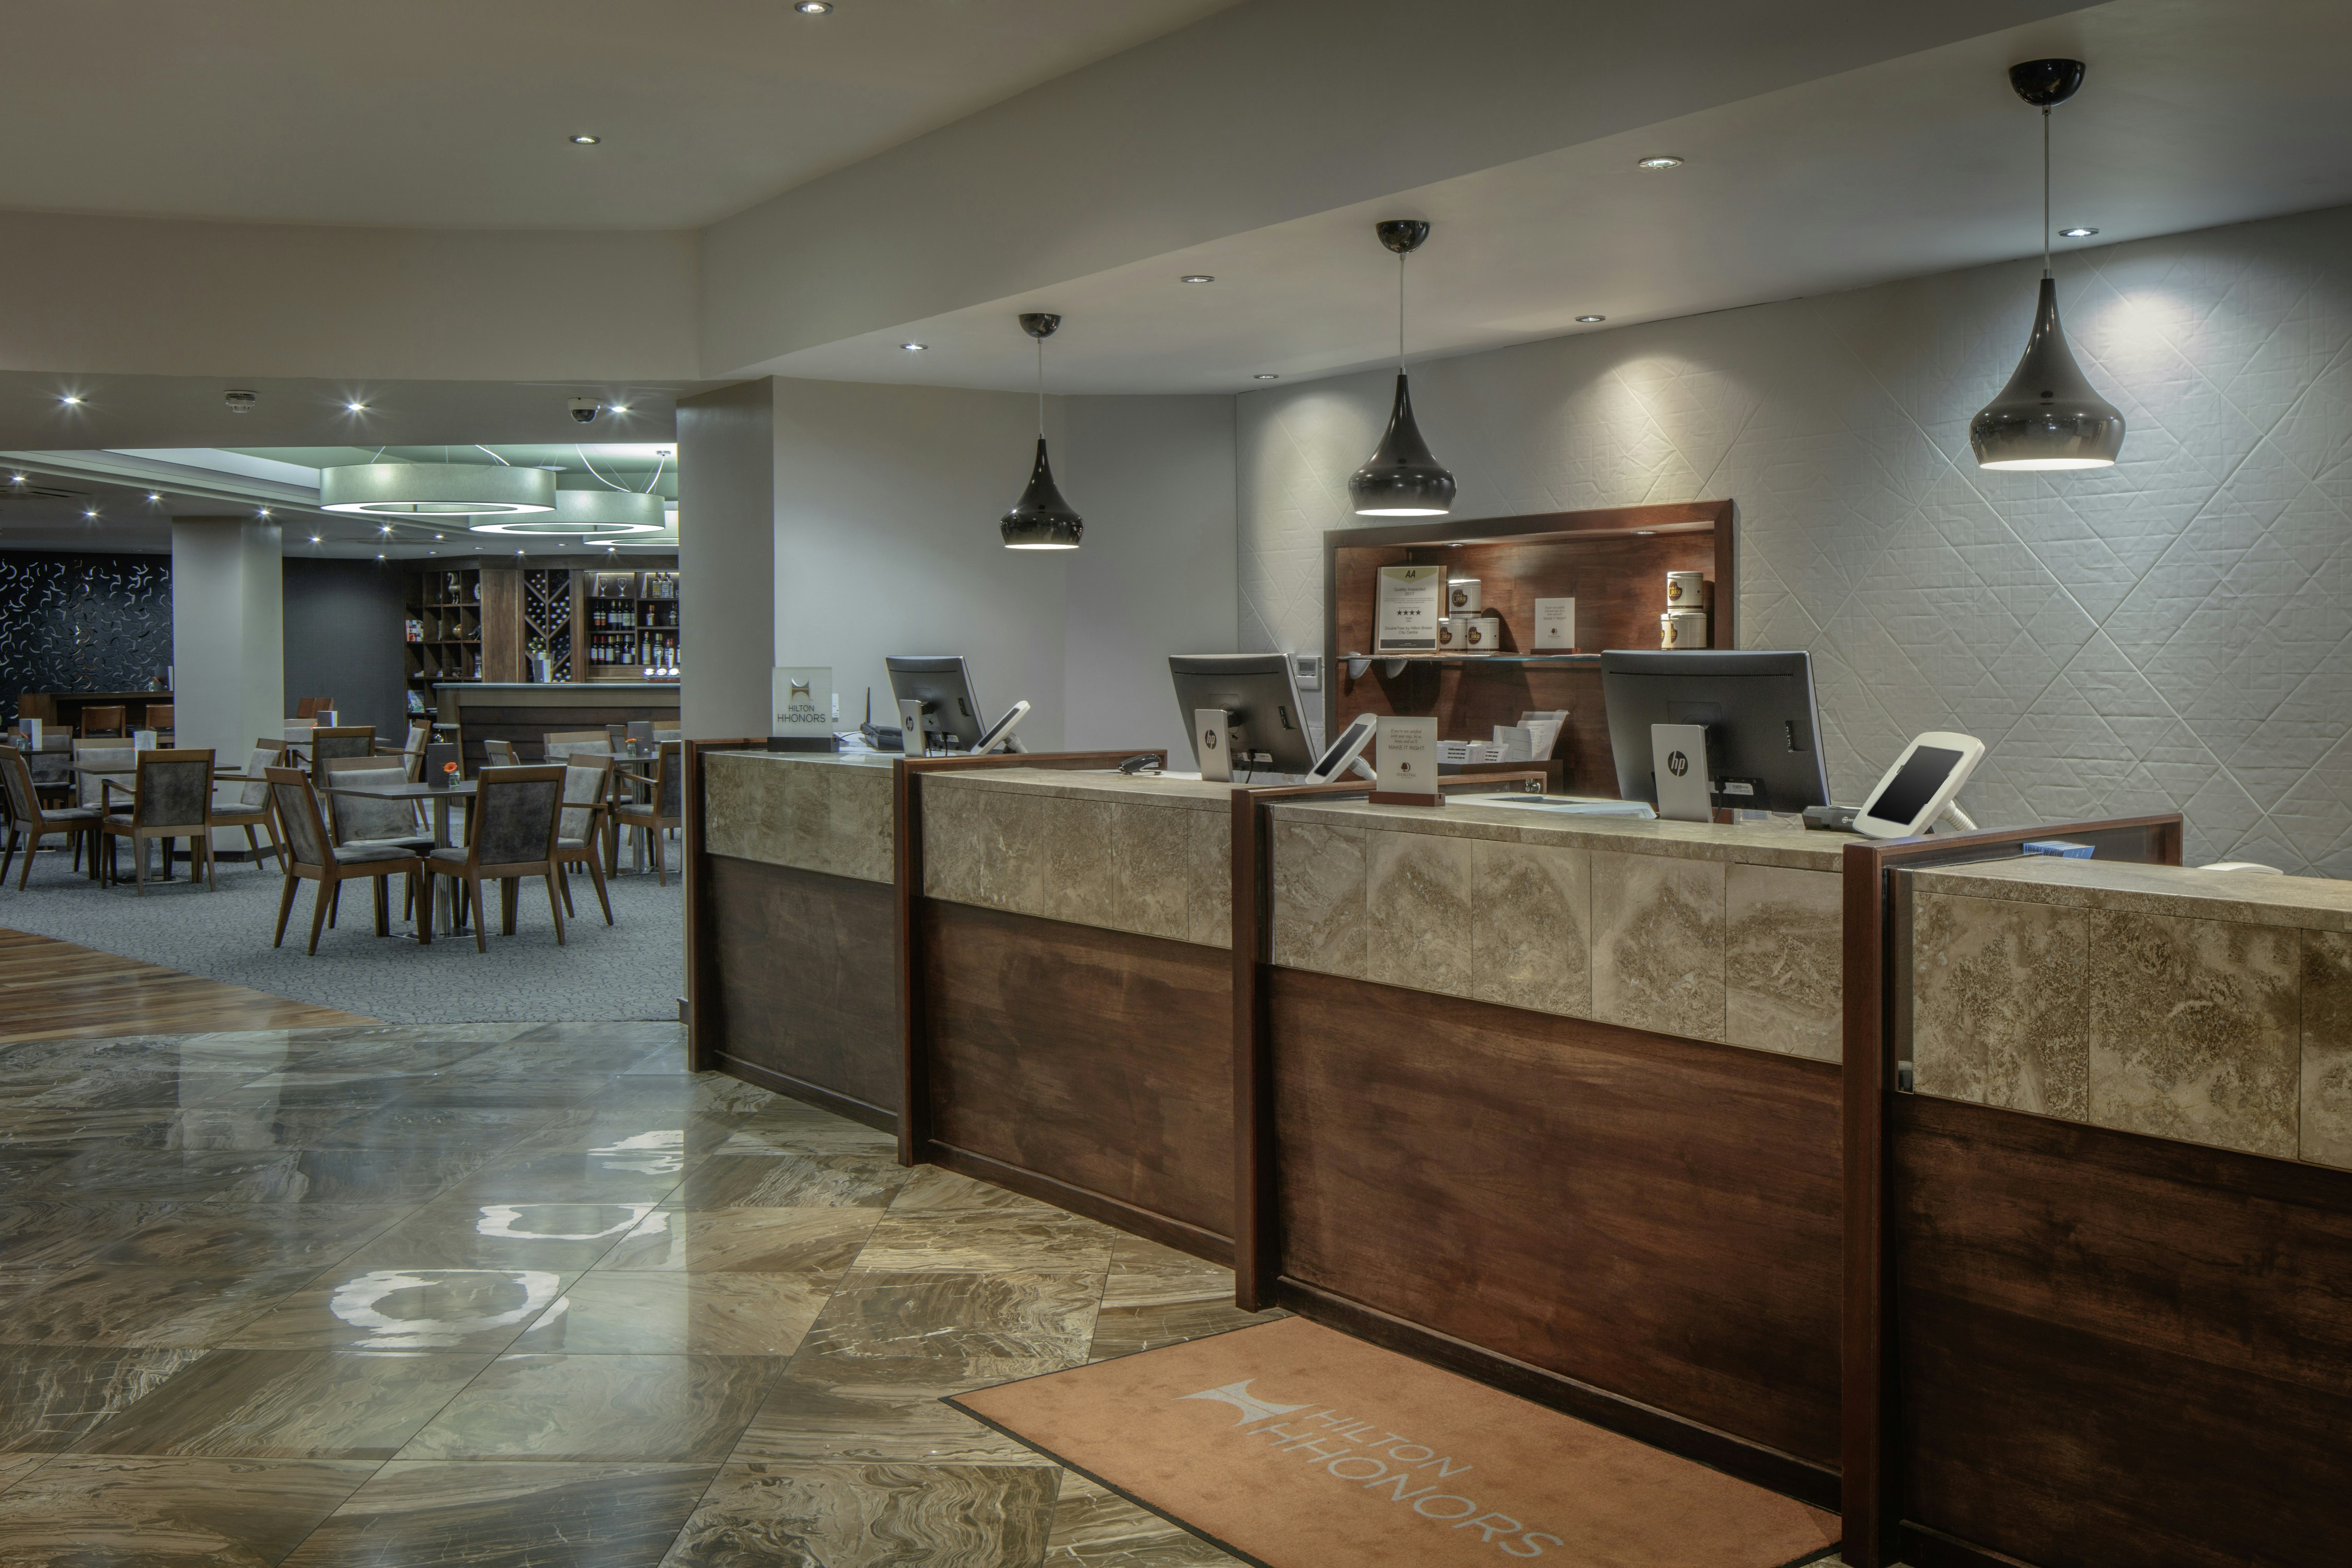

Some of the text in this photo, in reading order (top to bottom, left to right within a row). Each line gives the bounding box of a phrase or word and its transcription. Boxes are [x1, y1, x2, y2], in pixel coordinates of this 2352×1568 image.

[1405, 570, 1415, 578] AA
[1668, 585, 1681, 596] Cookie
[1453, 593, 1467, 603] Cookie
[1440, 631, 1451, 640] Cookie
[1468, 631, 1480, 640] Cookie
[777, 714, 826, 723] HHONORS
[907, 716, 913, 731] hp
[1206, 729, 1215, 750] hp
[1670, 750, 1686, 777] hp
[1305, 1409, 1473, 1478] HILTON
[1246, 1422, 1564, 1558] HHONORS
